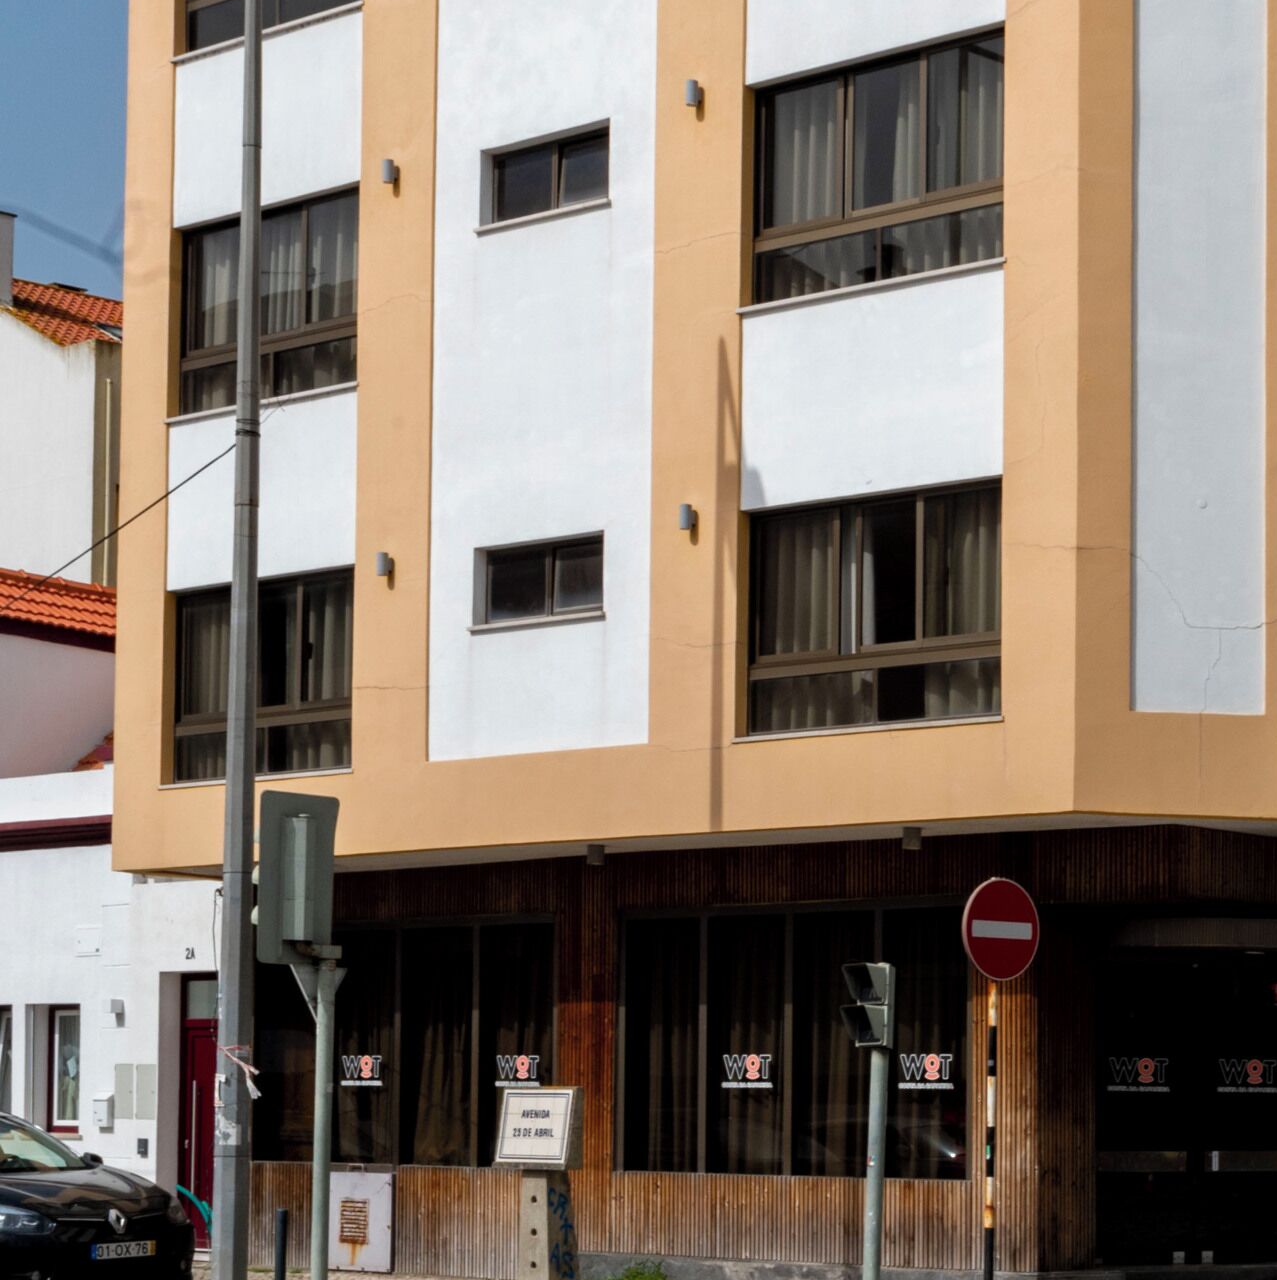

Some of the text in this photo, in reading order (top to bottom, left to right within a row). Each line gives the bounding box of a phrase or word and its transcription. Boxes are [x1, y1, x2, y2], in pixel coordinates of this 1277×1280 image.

[185, 947, 196, 960] 2A
[341, 1055, 382, 1079] WOT
[496, 1055, 540, 1079] WOT
[722, 1054, 772, 1080] WOT
[900, 1053, 953, 1081] WOT
[1108, 1057, 1169, 1084] WOT
[1218, 1059, 1277, 1085] WOT
[521, 1109, 550, 1119] AVENIDA
[513, 1128, 554, 1138] 25 DE ABRIL
